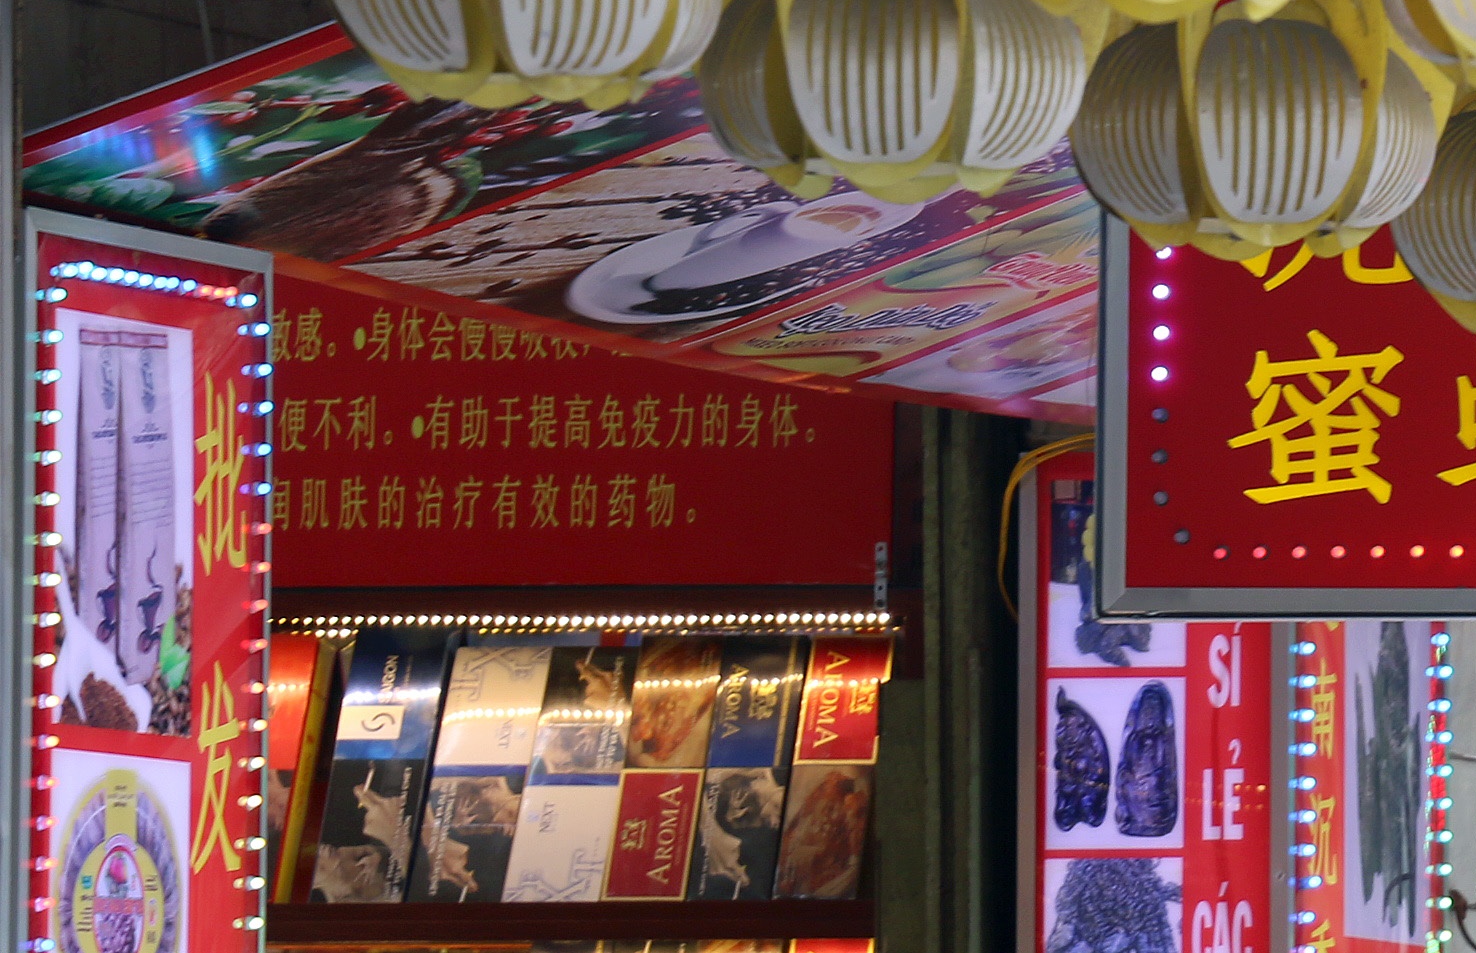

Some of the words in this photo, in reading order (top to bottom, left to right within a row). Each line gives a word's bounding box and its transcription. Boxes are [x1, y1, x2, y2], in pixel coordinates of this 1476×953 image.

[646, 784, 684, 884] AROMA
[1202, 738, 1245, 840] LẺ
[1191, 882, 1254, 953] CÁC
